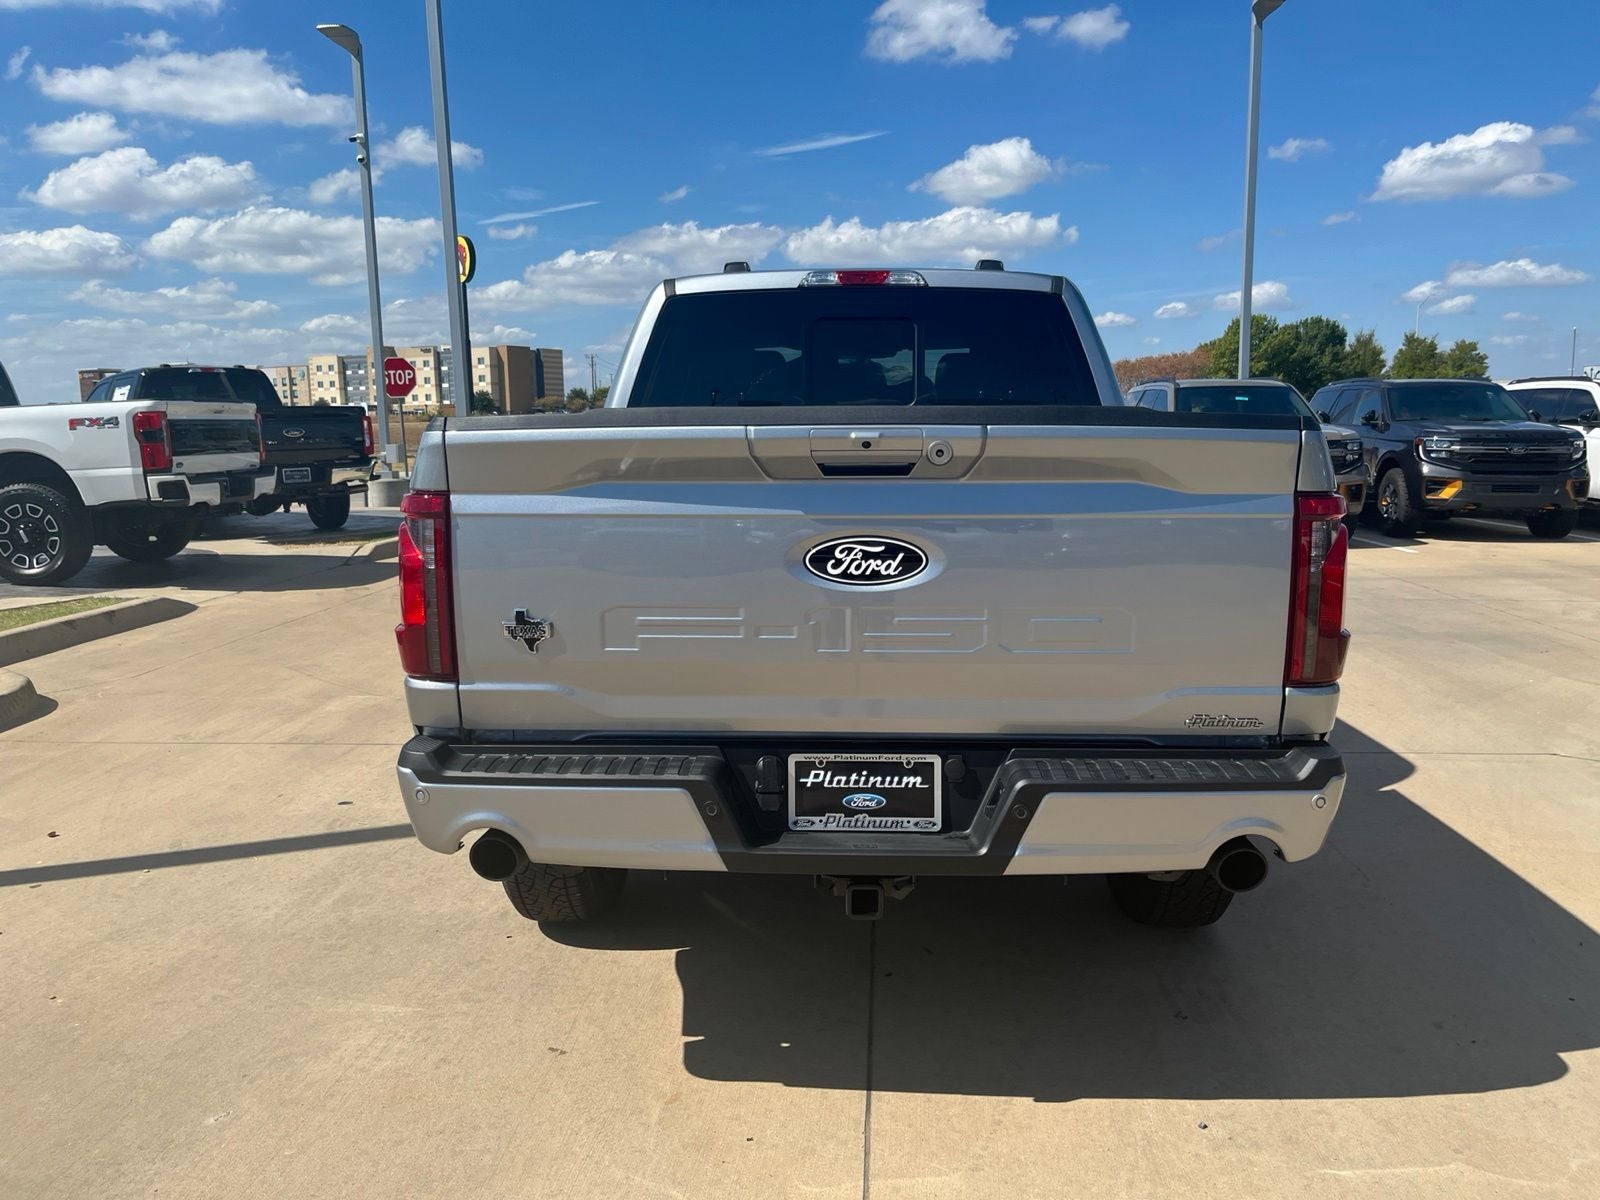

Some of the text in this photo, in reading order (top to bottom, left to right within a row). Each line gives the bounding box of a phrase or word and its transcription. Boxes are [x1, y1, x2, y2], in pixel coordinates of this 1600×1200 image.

[68, 416, 120, 431] FX4
[827, 544, 906, 578] Ford
[503, 624, 547, 638] TEXAS
[601, 605, 1137, 654] F-150
[1184, 713, 1265, 729] Platinum
[803, 754, 928, 762] www.PlatinumFord.com
[799, 770, 930, 789] Platinum
[850, 795, 878, 808] Ford
[824, 814, 912, 829] Platinum
